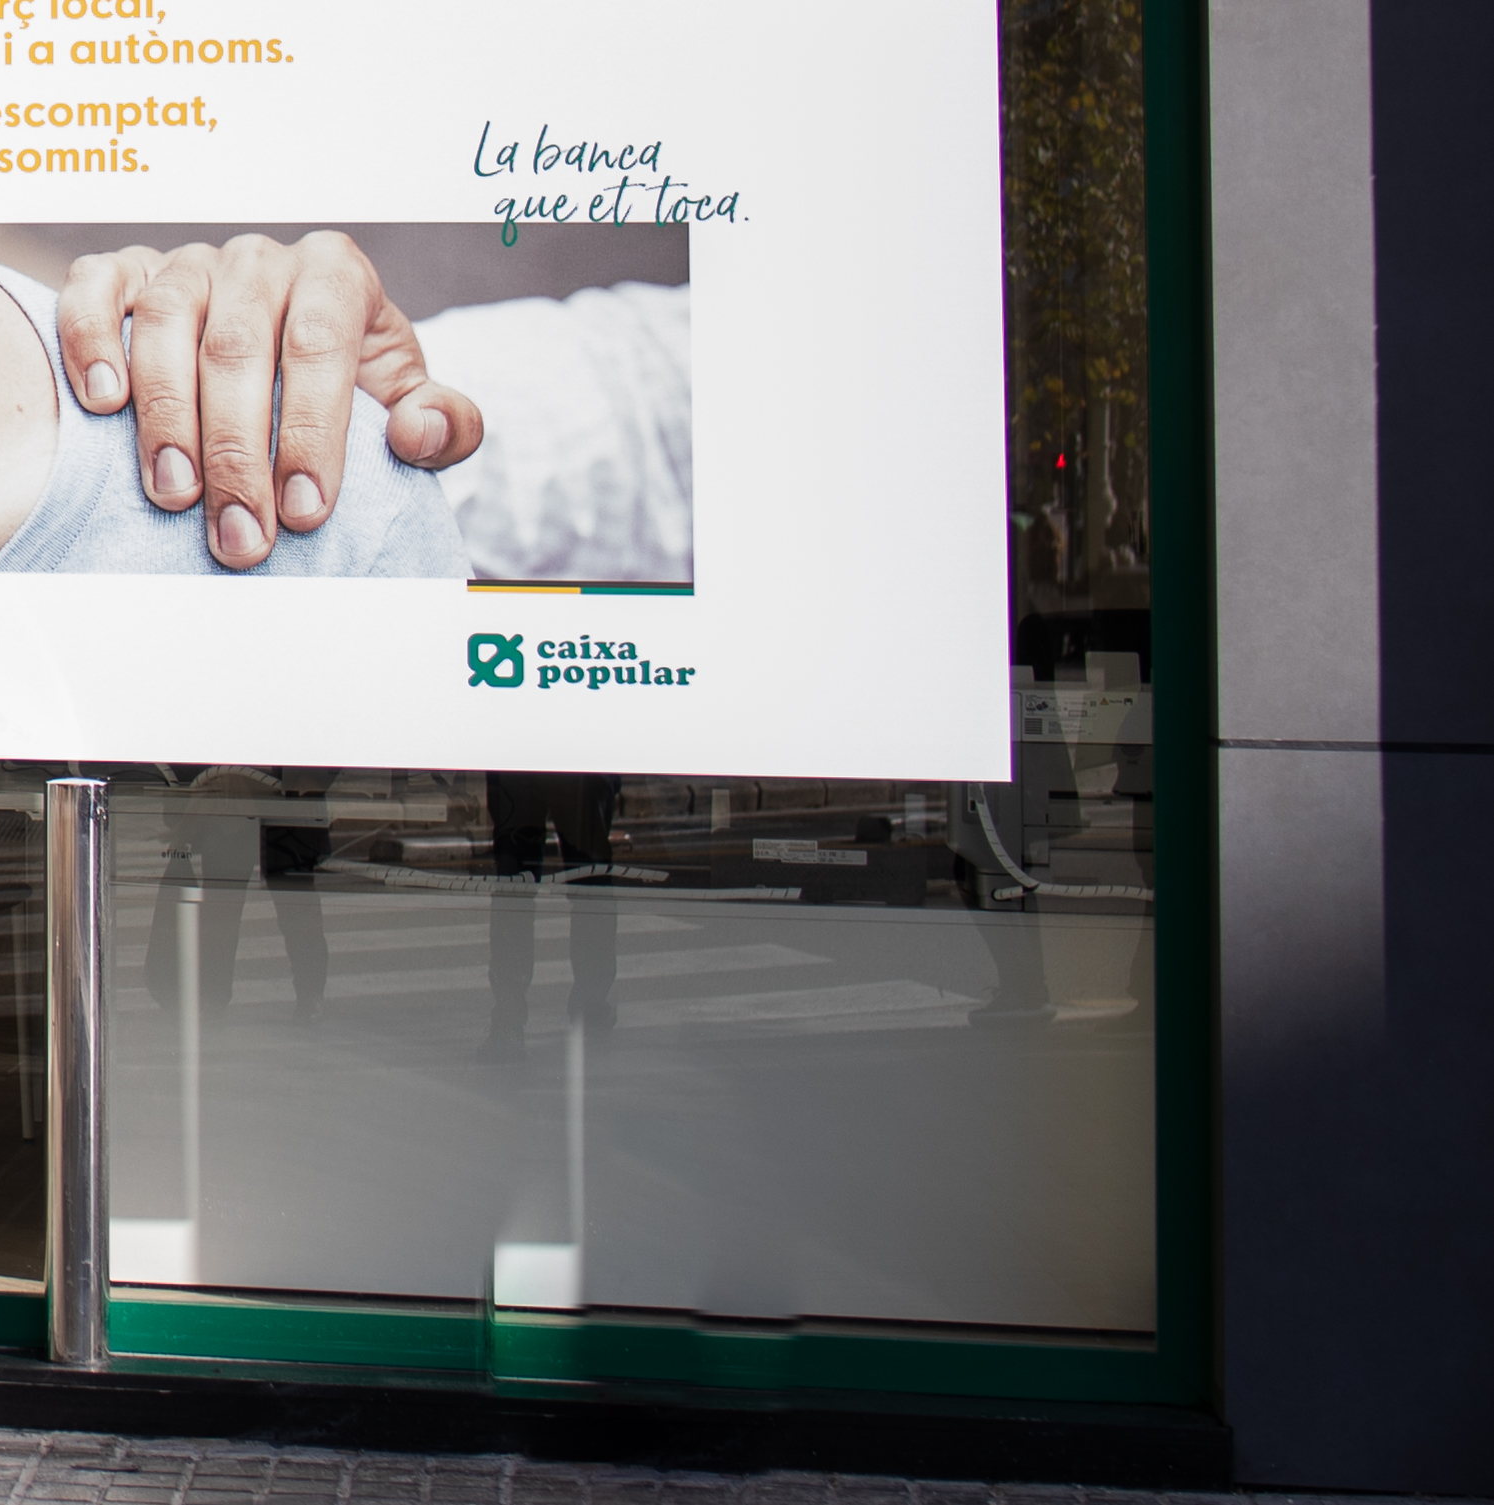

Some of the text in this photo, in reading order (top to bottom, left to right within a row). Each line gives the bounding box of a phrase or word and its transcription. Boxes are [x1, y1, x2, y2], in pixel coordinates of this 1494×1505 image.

[4, 31, 13, 65] i
[28, 40, 54, 65] a
[70, 29, 294, 65] autònoms.
[473, 120, 663, 177] La banca
[494, 175, 750, 247] que et toca.
[537, 634, 639, 660] caixa
[536, 660, 696, 690] popular
